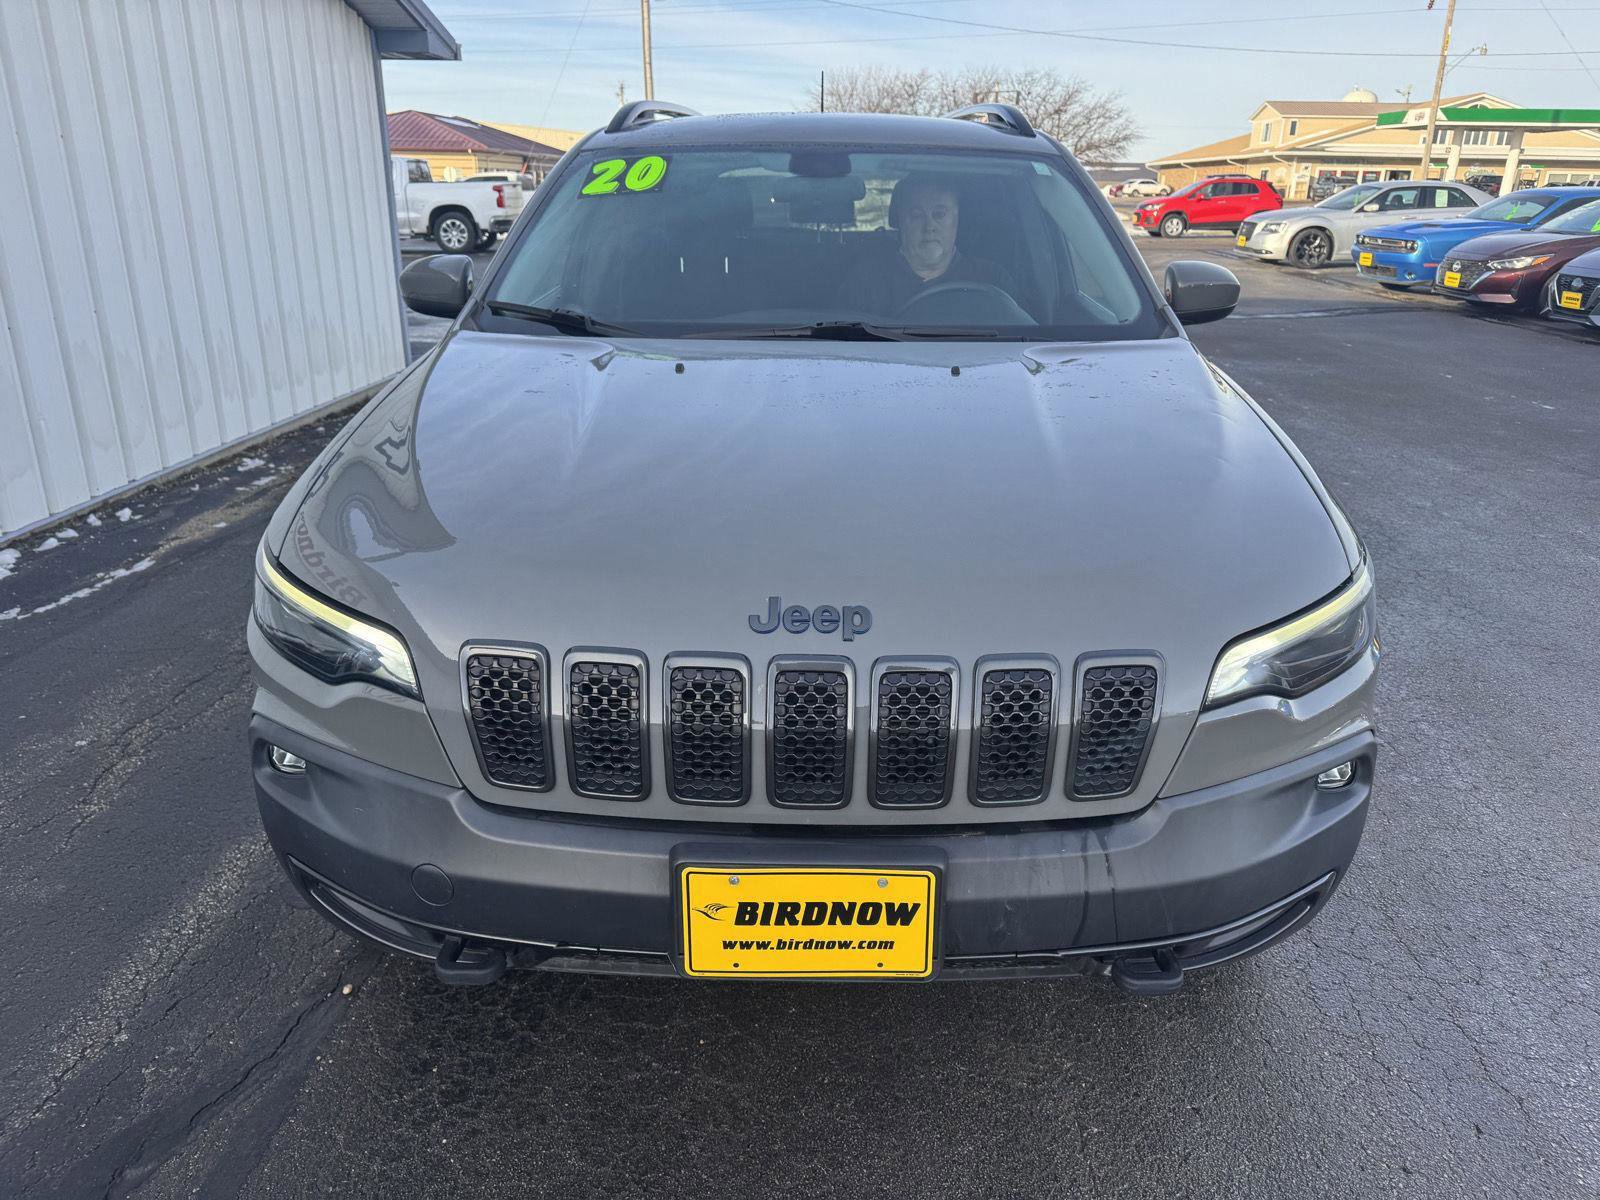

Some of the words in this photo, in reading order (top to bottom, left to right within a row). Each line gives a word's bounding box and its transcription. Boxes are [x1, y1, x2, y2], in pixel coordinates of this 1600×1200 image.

[582, 155, 667, 195] 20
[748, 596, 872, 642] Jeep
[734, 901, 921, 926] BIRDNOW
[722, 938, 895, 950] www.birdnow.com
